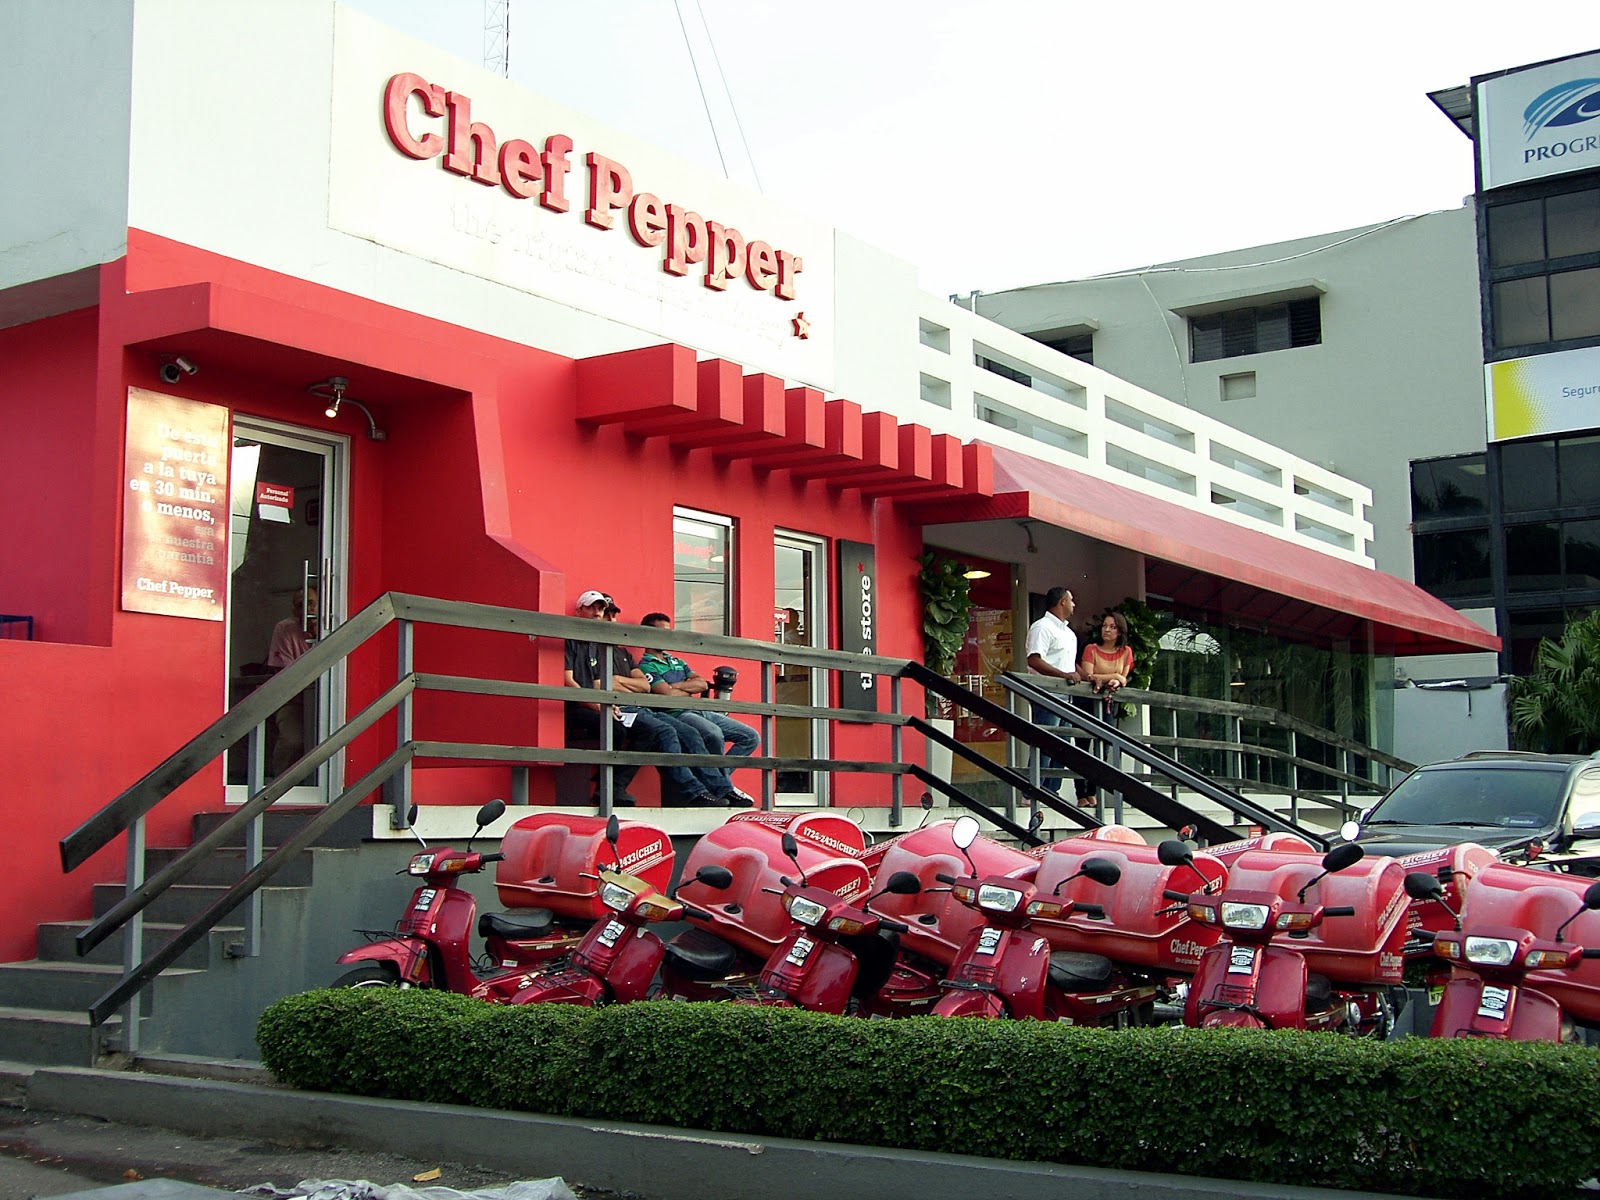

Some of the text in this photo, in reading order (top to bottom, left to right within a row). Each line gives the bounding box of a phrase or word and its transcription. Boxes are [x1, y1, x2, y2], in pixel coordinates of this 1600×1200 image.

[1524, 135, 1600, 164] PROGR
[383, 72, 573, 213] Chef
[584, 151, 802, 301] Pepper
[161, 447, 217, 466] puerta
[143, 461, 217, 486] a la tuya
[130, 479, 216, 504] en 30 min.
[157, 502, 215, 525] menos,
[165, 536, 214, 551] nuestra
[137, 577, 168, 593] Chef
[861, 575, 872, 640] store
[1170, 938, 1207, 959] Chef Pep
